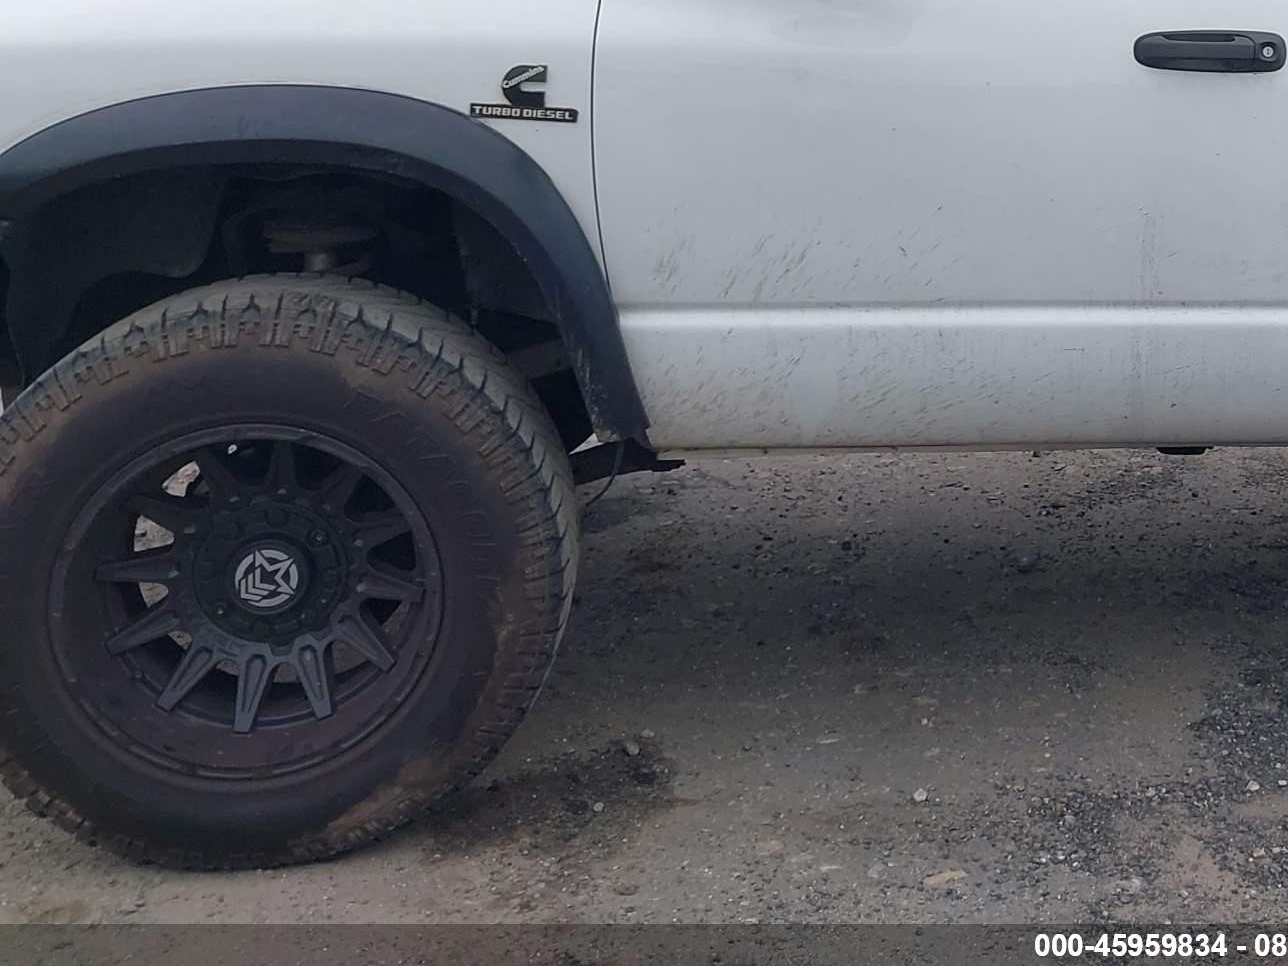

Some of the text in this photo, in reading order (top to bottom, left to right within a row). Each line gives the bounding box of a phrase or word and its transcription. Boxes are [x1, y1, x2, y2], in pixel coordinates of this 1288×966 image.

[502, 65, 544, 89] Cummins
[472, 105, 574, 120] TURBO DIESEL
